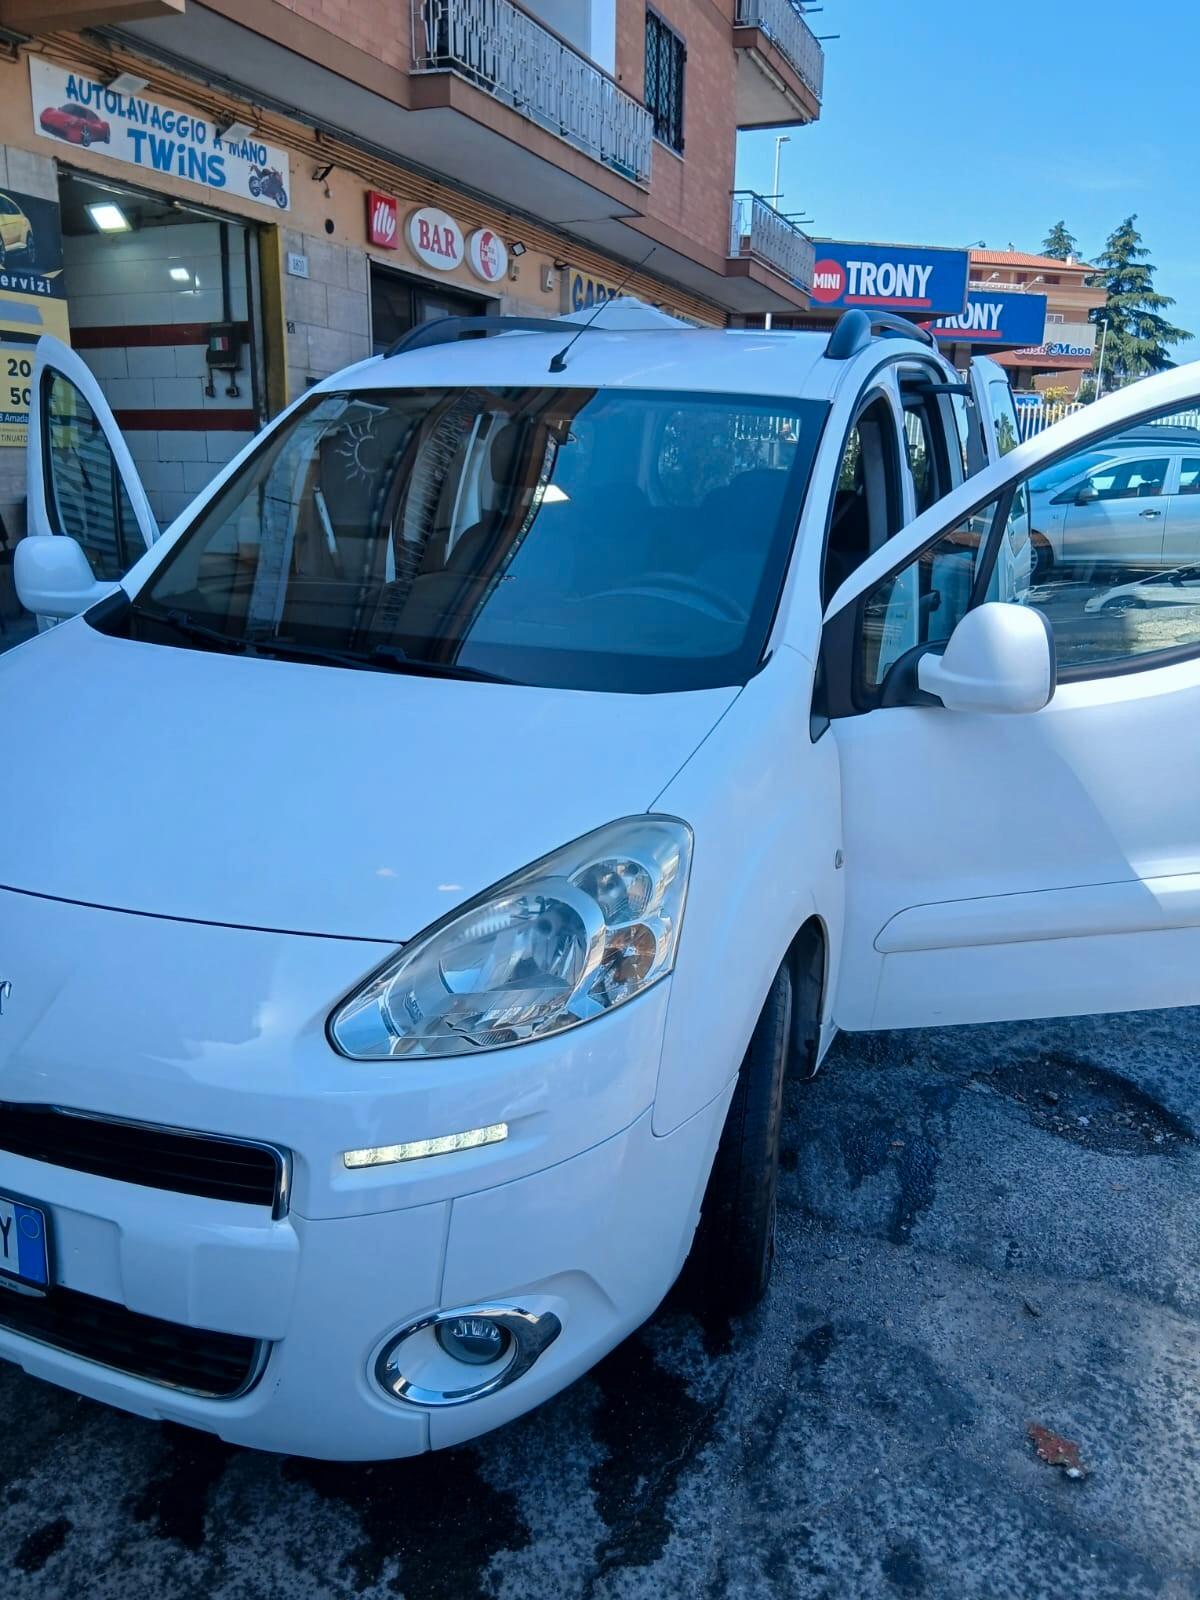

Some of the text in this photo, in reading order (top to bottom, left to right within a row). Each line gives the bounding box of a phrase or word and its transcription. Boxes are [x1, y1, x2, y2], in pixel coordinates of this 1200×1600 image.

[66, 74, 268, 166] AUTOLAVAGGIO A MANO
[373, 201, 396, 242] illy
[418, 218, 458, 260] BAR
[1, 275, 51, 294] ervizi
[813, 272, 840, 290] MINI
[846, 261, 933, 298] TRONY
[8, 358, 32, 378] 20
[0, 1215, 12, 1258] Y
